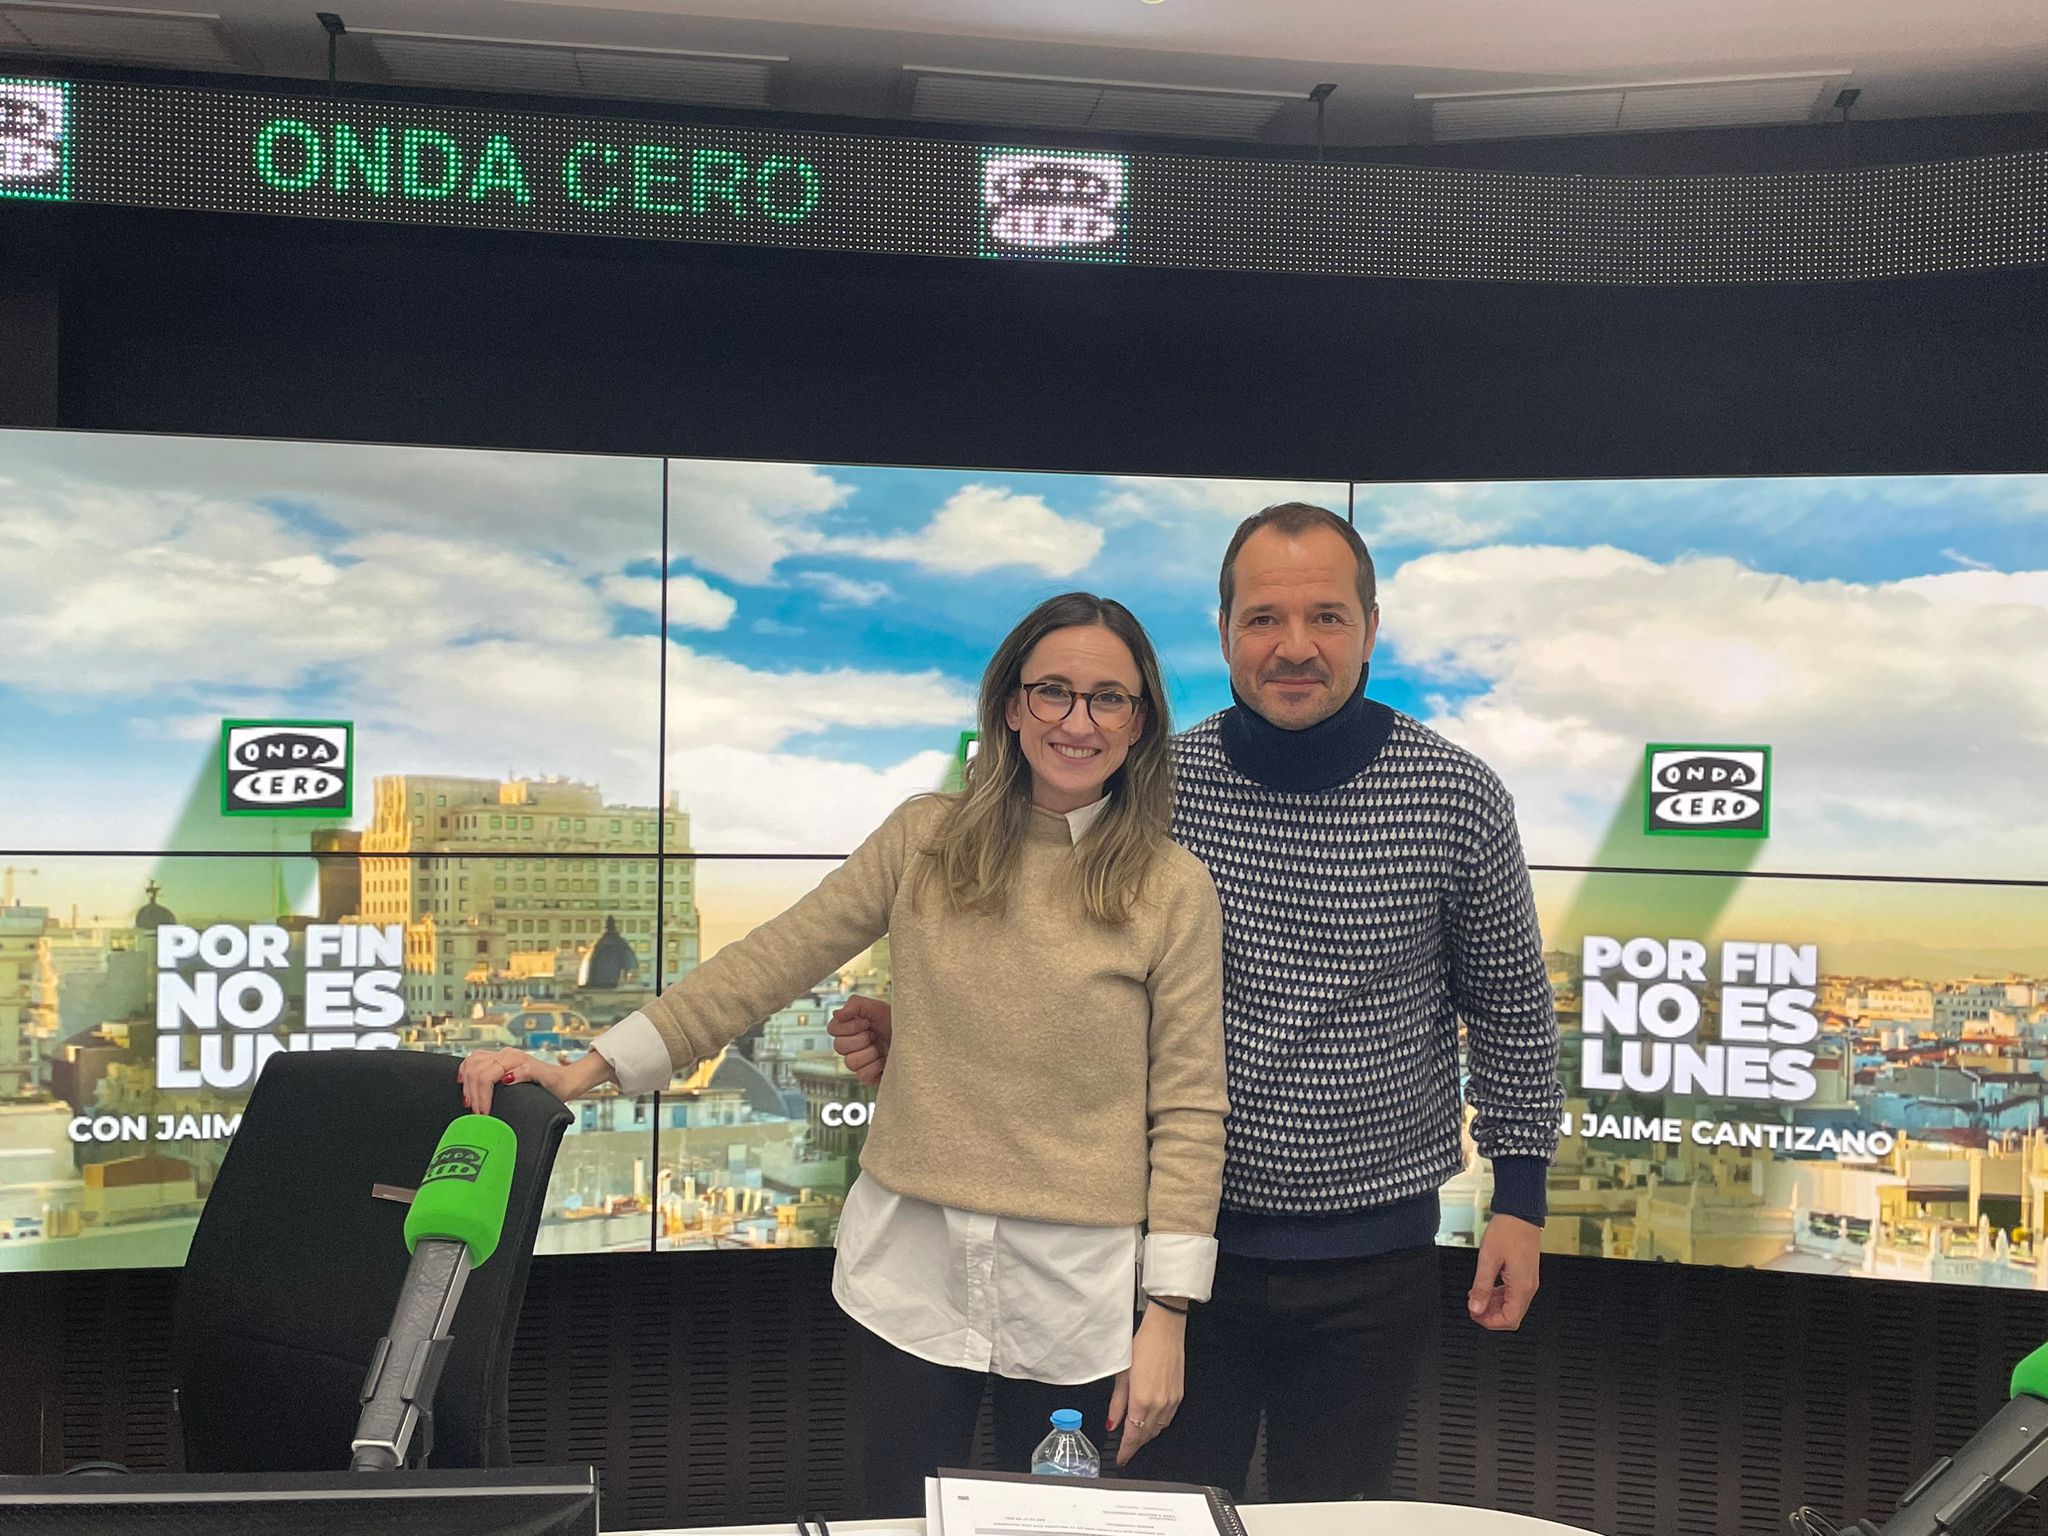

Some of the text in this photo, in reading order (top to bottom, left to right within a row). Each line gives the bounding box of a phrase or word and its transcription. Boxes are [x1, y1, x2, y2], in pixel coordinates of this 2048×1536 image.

[256, 119, 821, 224] ONDA CERO
[244, 742, 331, 762] ONDA
[249, 775, 330, 796] CERO
[1665, 765, 1747, 785] ONDA
[1669, 797, 1746, 816] CERO
[156, 923, 404, 968] POR FIN
[1582, 935, 1818, 986] POR FIN
[156, 969, 405, 1030] NO ES
[1582, 980, 1819, 1045] NO ES
[1581, 1039, 1818, 1100] LUNES
[67, 1113, 243, 1142] CON JAIM
[1579, 1112, 1683, 1143] JAIME
[1691, 1120, 1893, 1157] CANTIZANO
